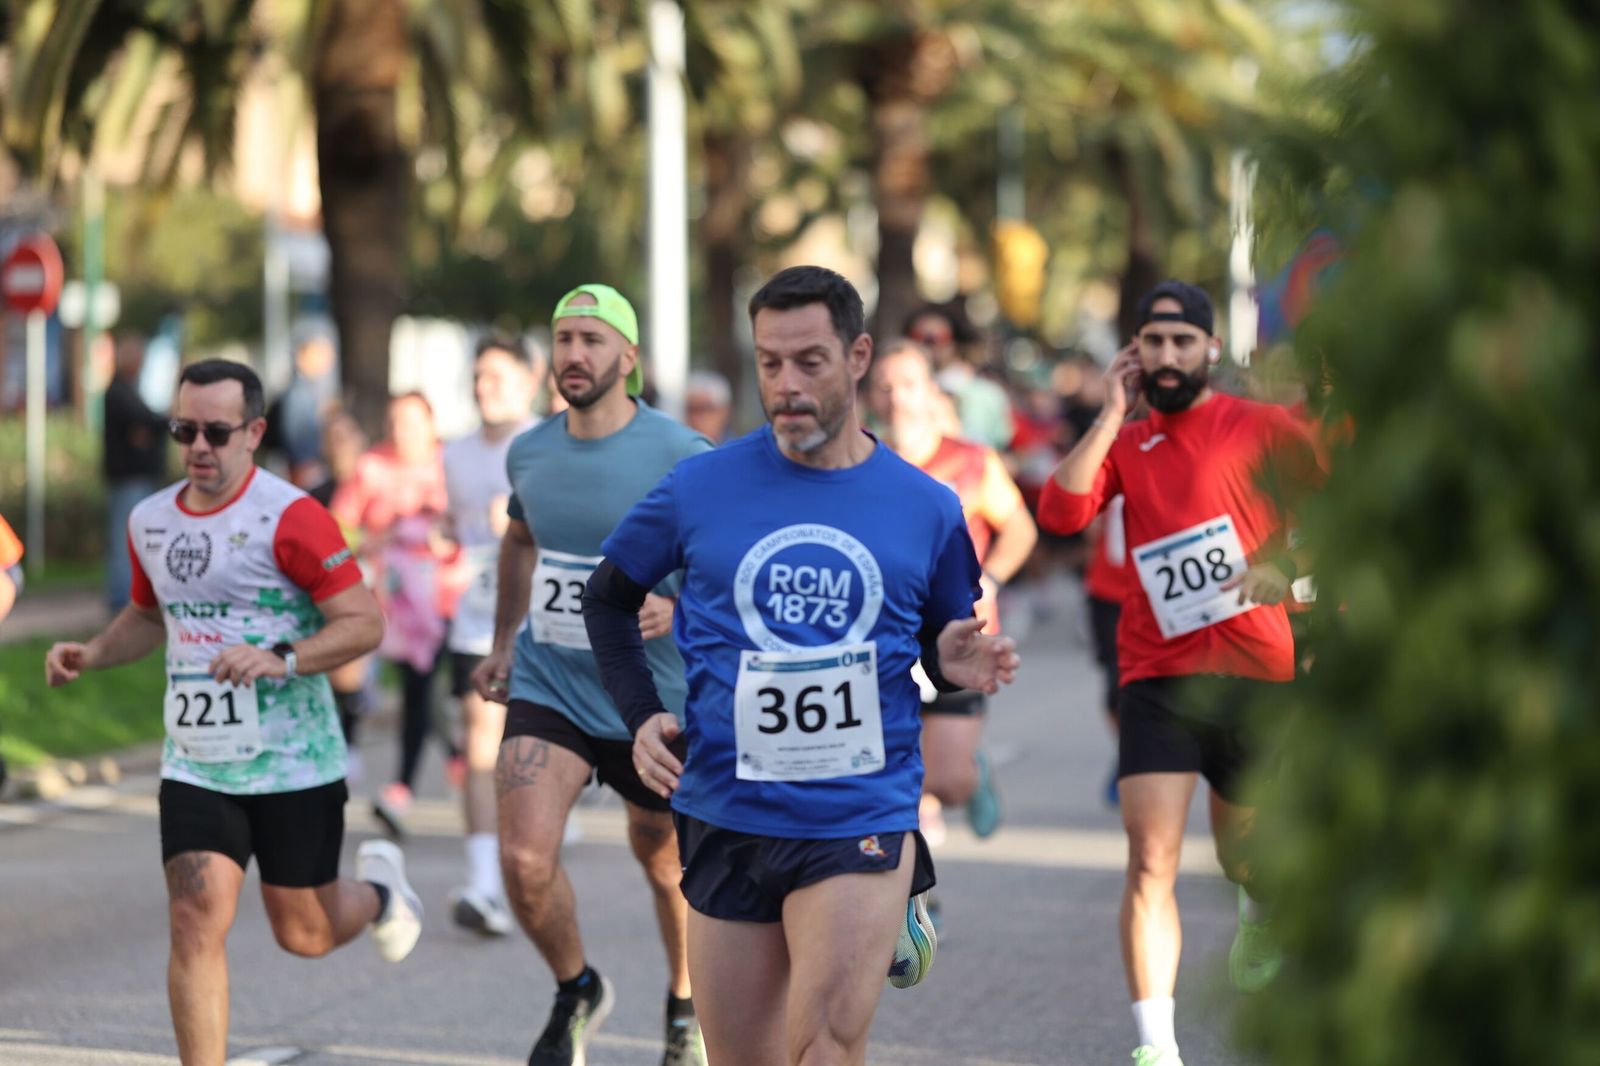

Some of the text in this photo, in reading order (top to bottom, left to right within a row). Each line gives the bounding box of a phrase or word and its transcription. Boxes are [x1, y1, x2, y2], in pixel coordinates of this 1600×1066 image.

[768, 563, 852, 599] RCM
[1155, 547, 1233, 601] 208
[544, 578, 586, 615] 23
[766, 592, 849, 629] 1873
[175, 690, 243, 726] 221
[757, 680, 862, 735] 361
